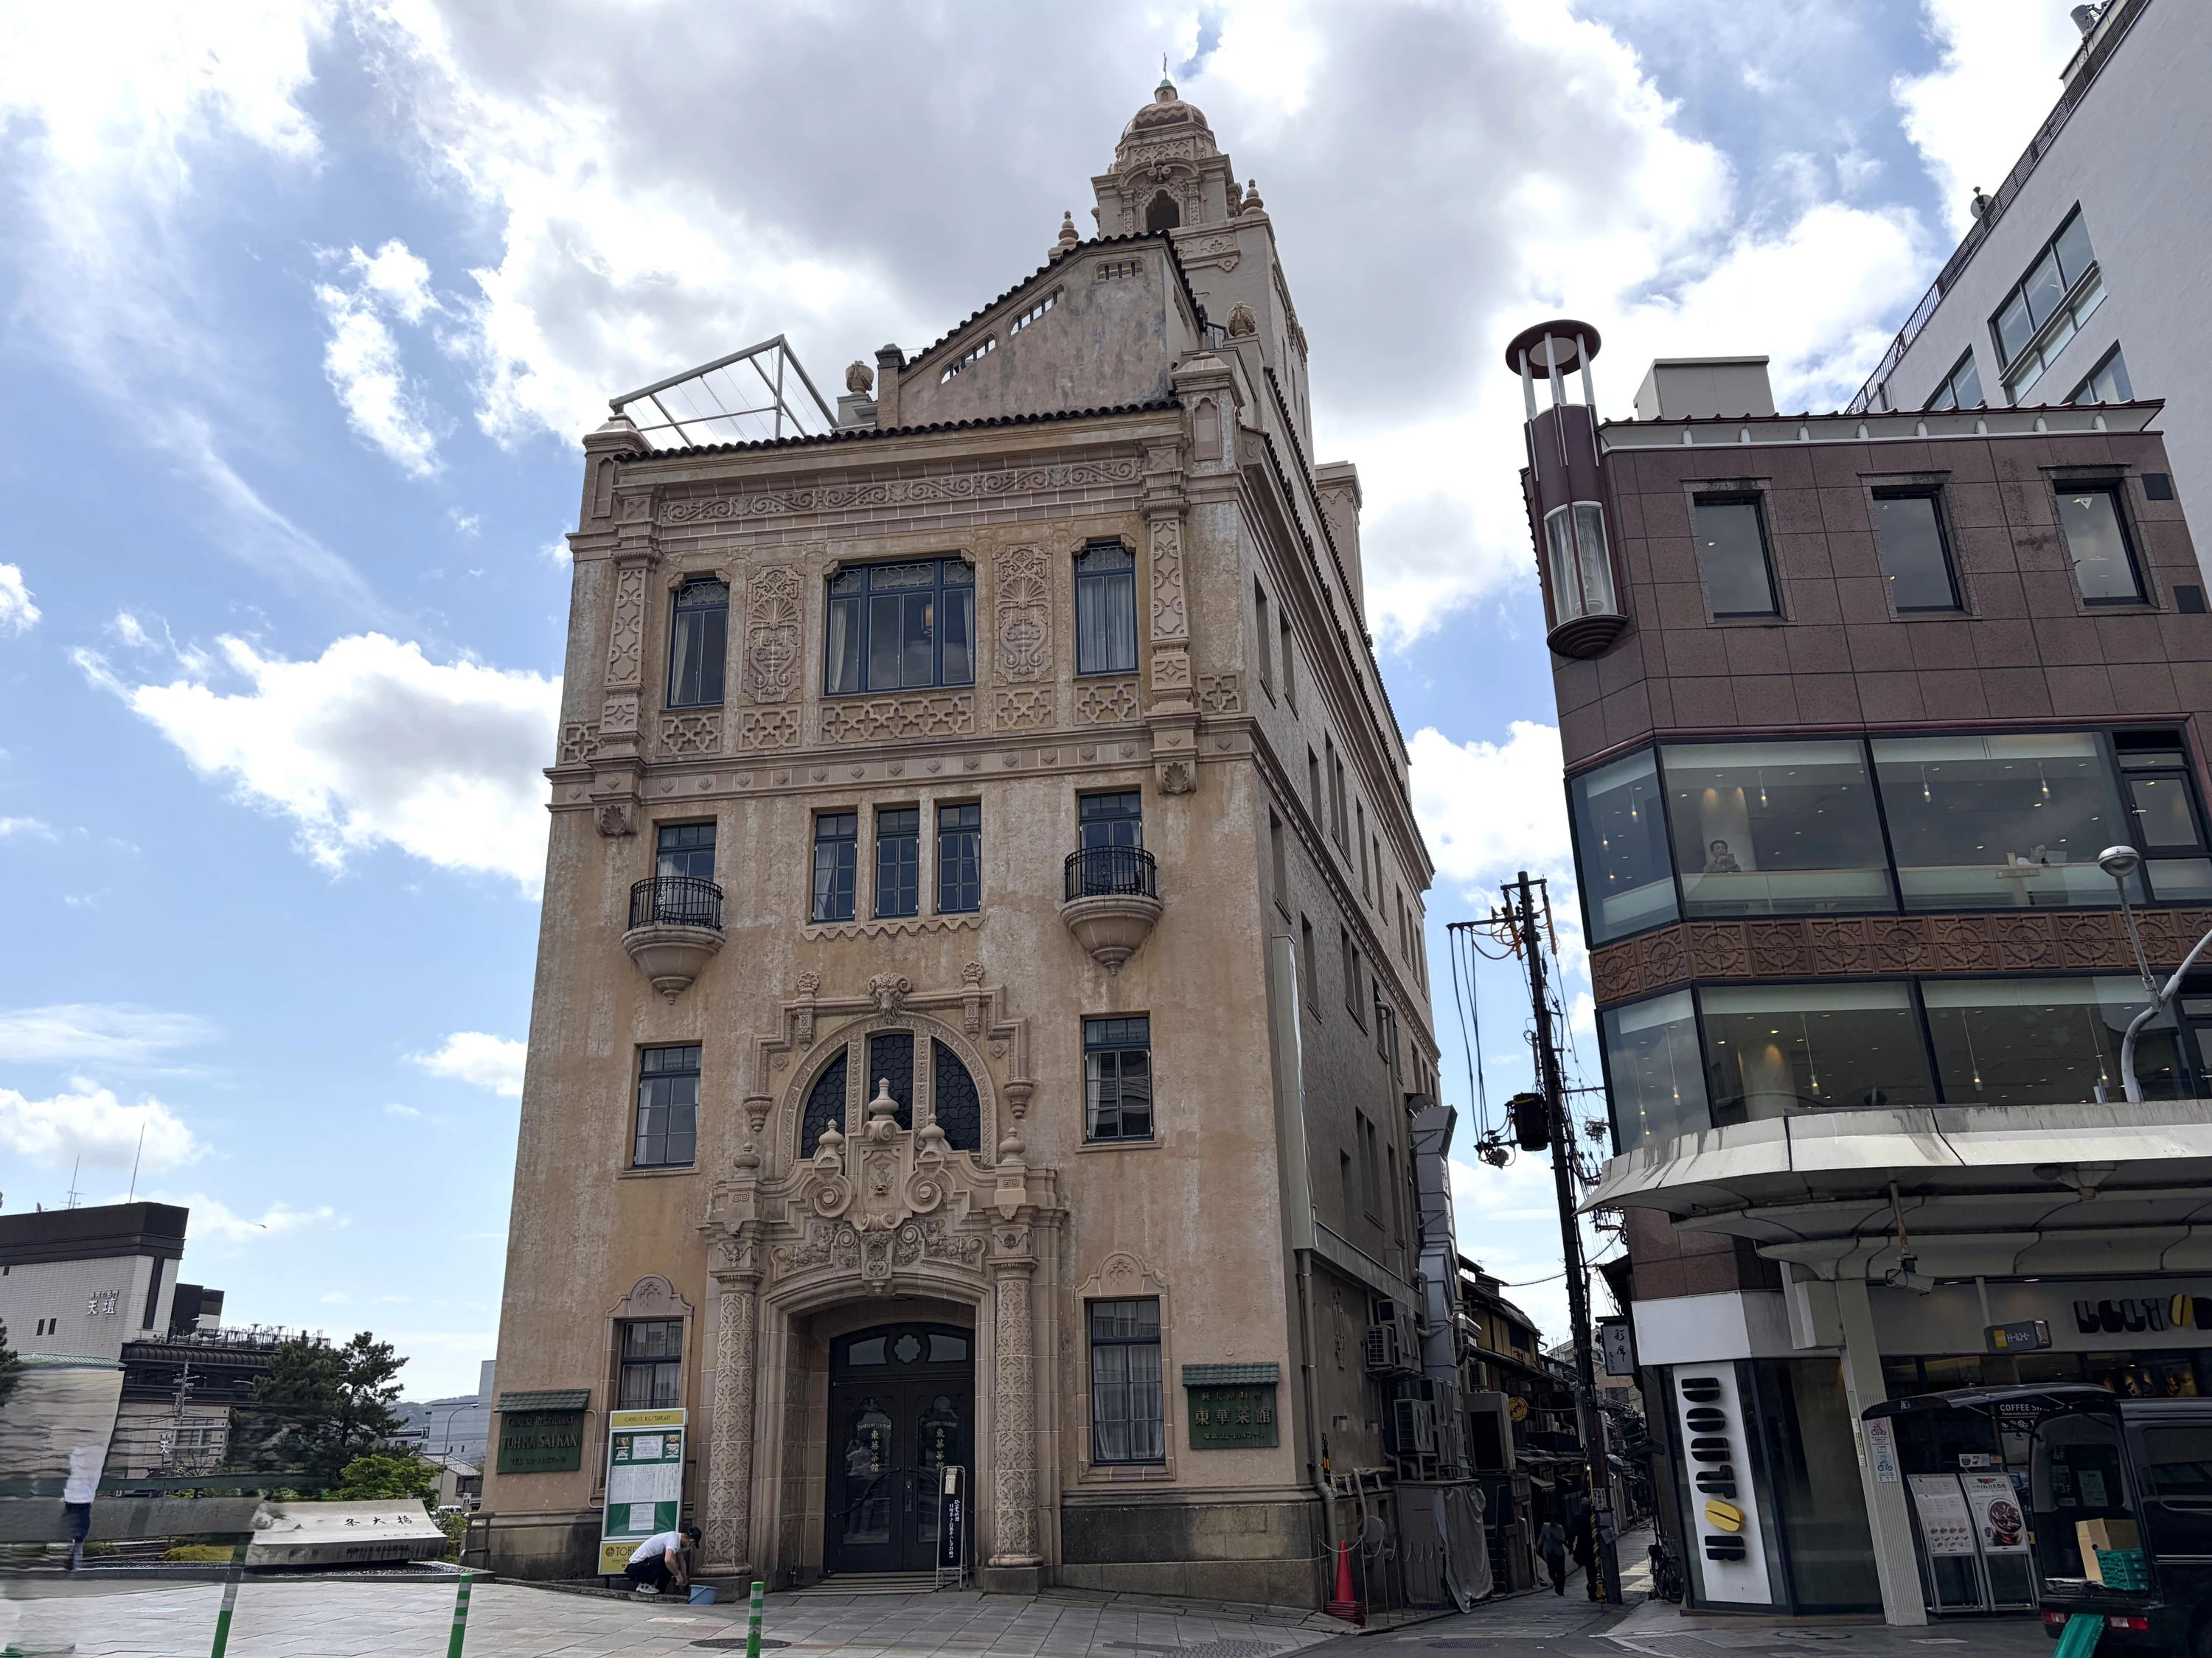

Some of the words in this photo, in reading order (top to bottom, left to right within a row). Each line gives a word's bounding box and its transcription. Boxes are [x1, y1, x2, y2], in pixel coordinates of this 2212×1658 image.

[86, 1298, 116, 1314] 天壇
[2000, 1404, 2030, 1412] COFFEE
[507, 1417, 534, 1427] CHINESE
[535, 1415, 575, 1427] RESTAURANT
[1195, 1407, 1271, 1426] 東華菜館
[503, 1435, 521, 1450] TOH
[524, 1435, 537, 1449] KA
